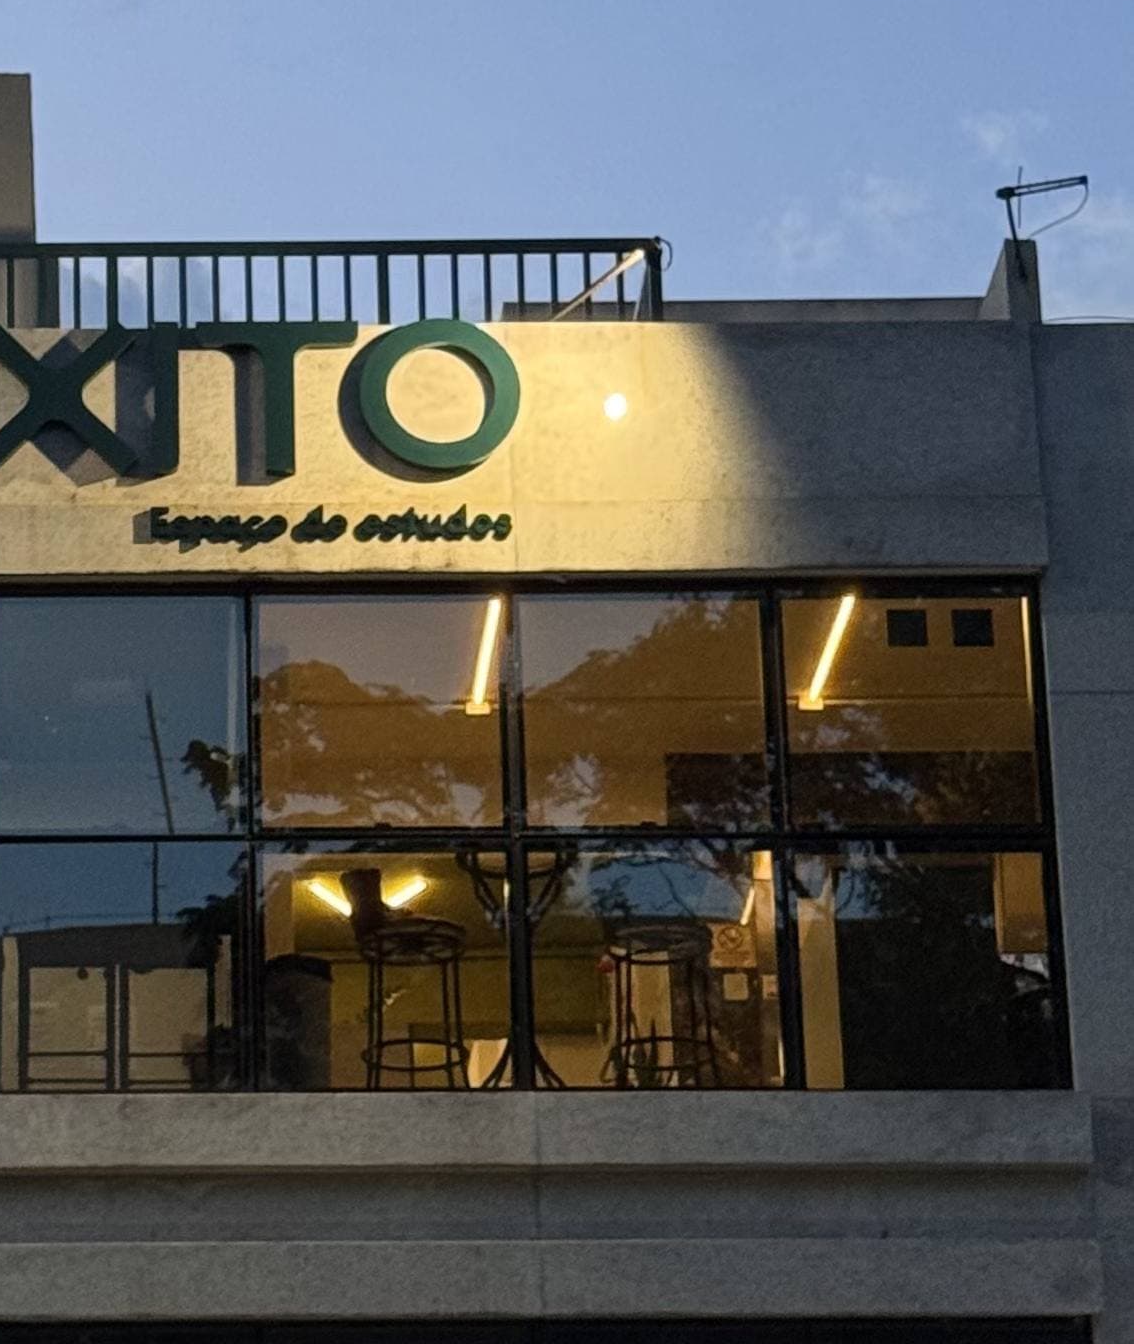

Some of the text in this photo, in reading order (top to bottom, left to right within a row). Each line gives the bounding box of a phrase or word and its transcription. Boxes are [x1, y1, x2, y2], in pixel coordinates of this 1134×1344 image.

[150, 503, 513, 547] Espaço de estudos
